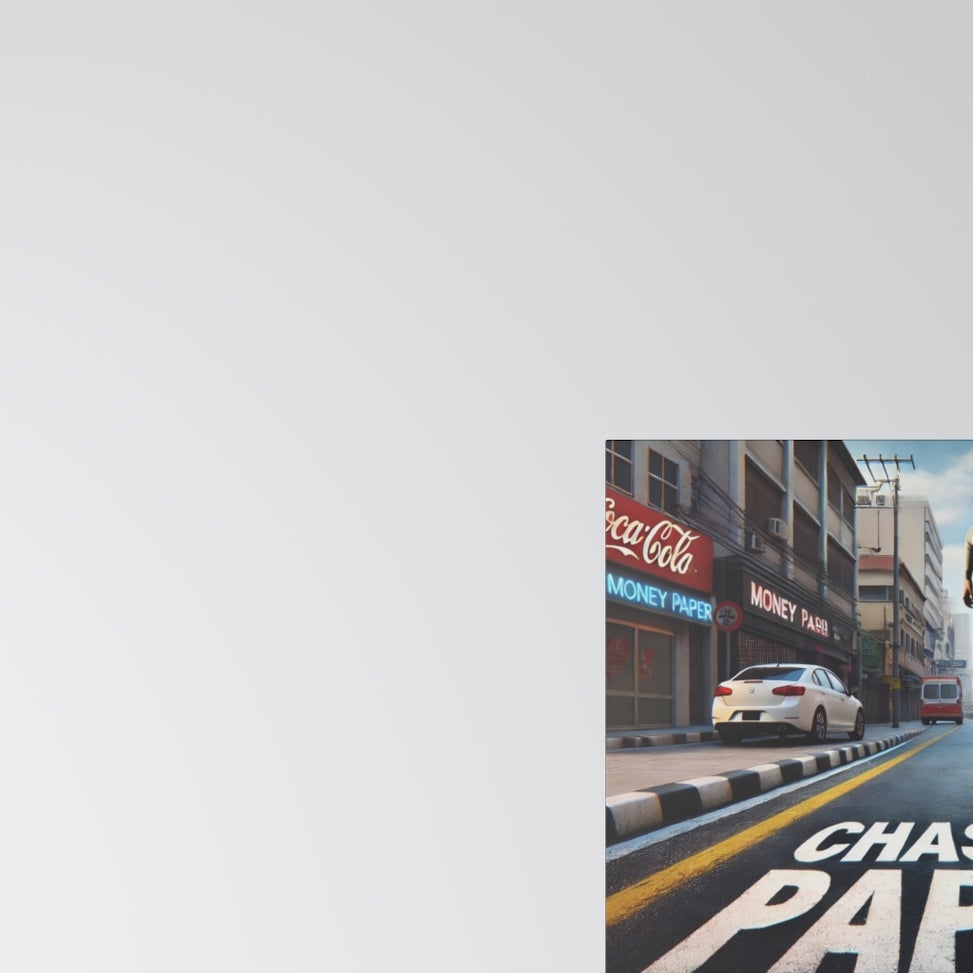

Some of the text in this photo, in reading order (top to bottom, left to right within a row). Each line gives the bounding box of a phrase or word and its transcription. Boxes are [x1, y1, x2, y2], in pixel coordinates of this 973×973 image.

[607, 573, 713, 621] MONEY PAPER
[751, 581, 797, 623] MONEY
